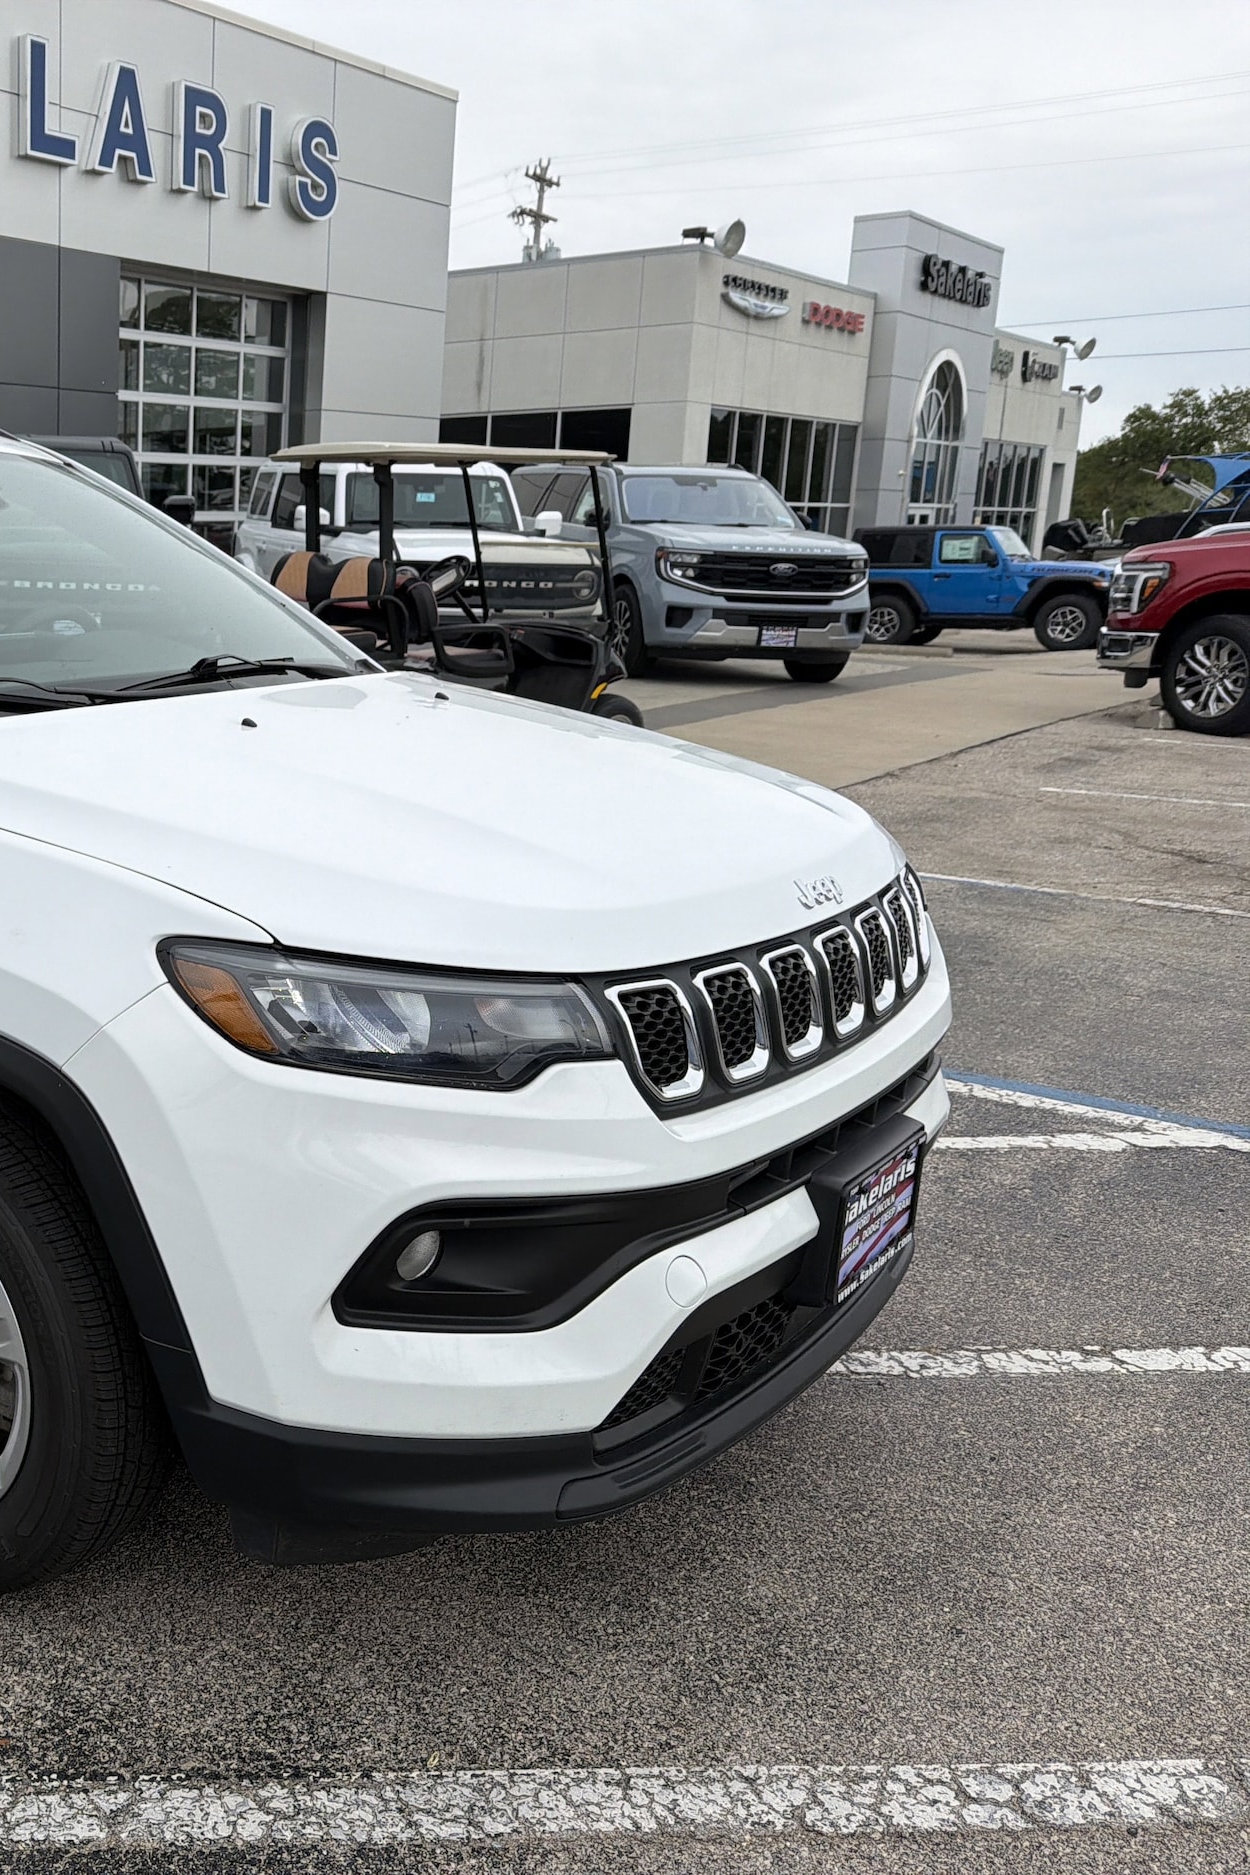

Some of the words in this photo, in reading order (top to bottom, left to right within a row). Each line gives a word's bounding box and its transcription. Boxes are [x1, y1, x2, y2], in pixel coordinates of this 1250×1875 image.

[921, 253, 992, 308] Sakelaris
[804, 302, 866, 333] DODGE
[13, 580, 145, 592] BRONCO
[464, 580, 554, 589] RONCO
[793, 875, 844, 911] Jeep
[855, 1213, 872, 1231] FORD
[872, 1193, 897, 1218] LINCOLN
[840, 1235, 861, 1261] RYSLER
[862, 1217, 881, 1242] DODGE
